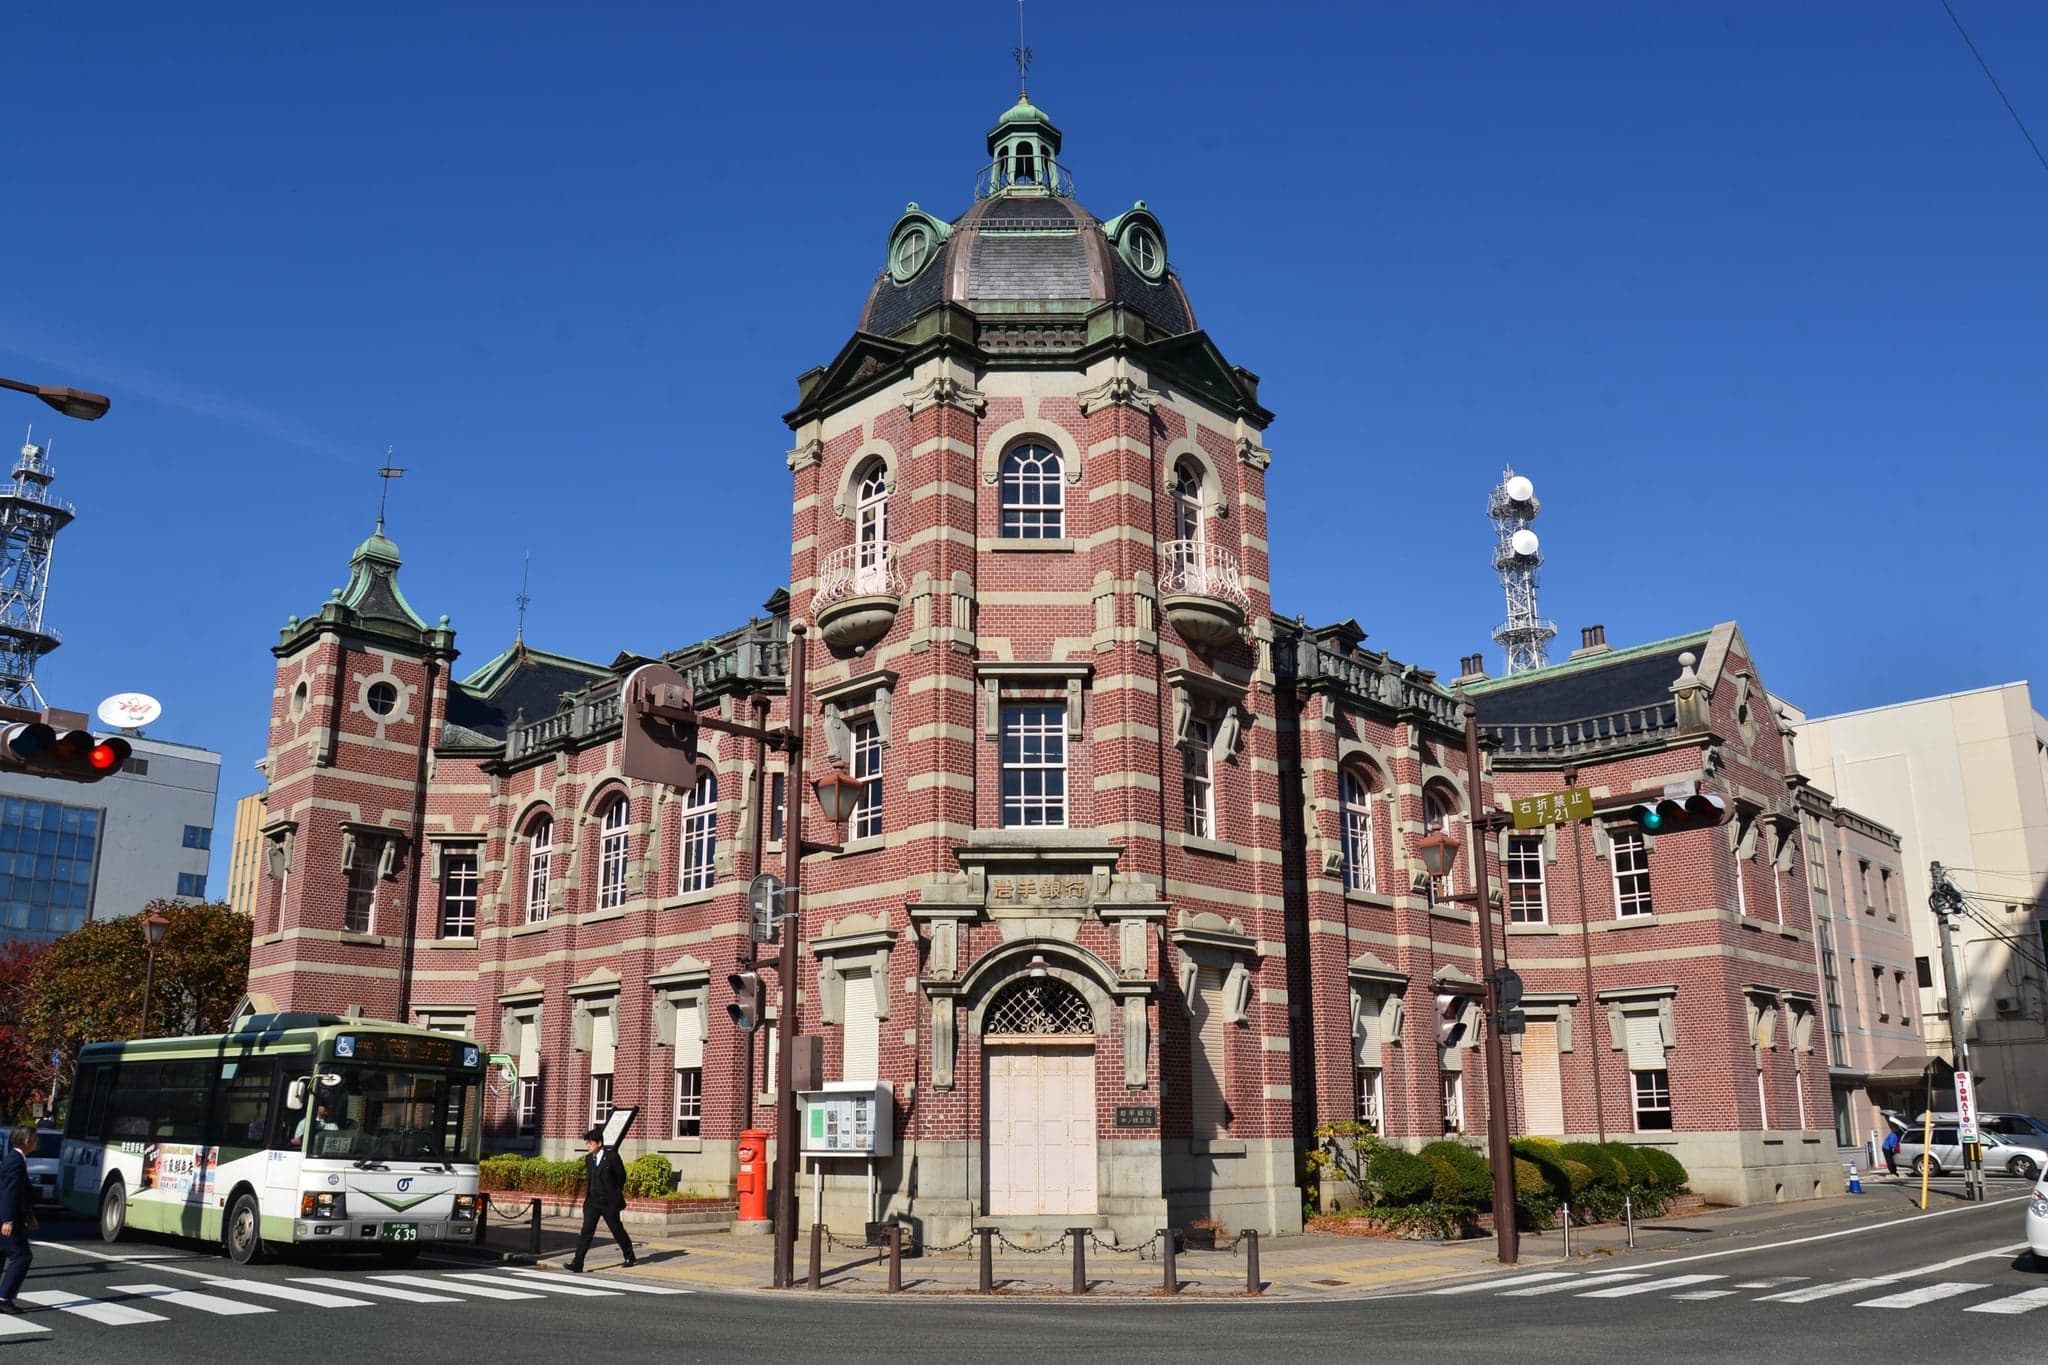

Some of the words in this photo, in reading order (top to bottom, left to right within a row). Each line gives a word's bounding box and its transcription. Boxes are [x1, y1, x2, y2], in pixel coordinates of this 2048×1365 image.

[1519, 791, 1583, 813] 右折禁止
[1536, 806, 1569, 824] 7-21
[993, 879, 1085, 899] 岩手銀行
[1959, 1081, 1970, 1123] TOMATO
